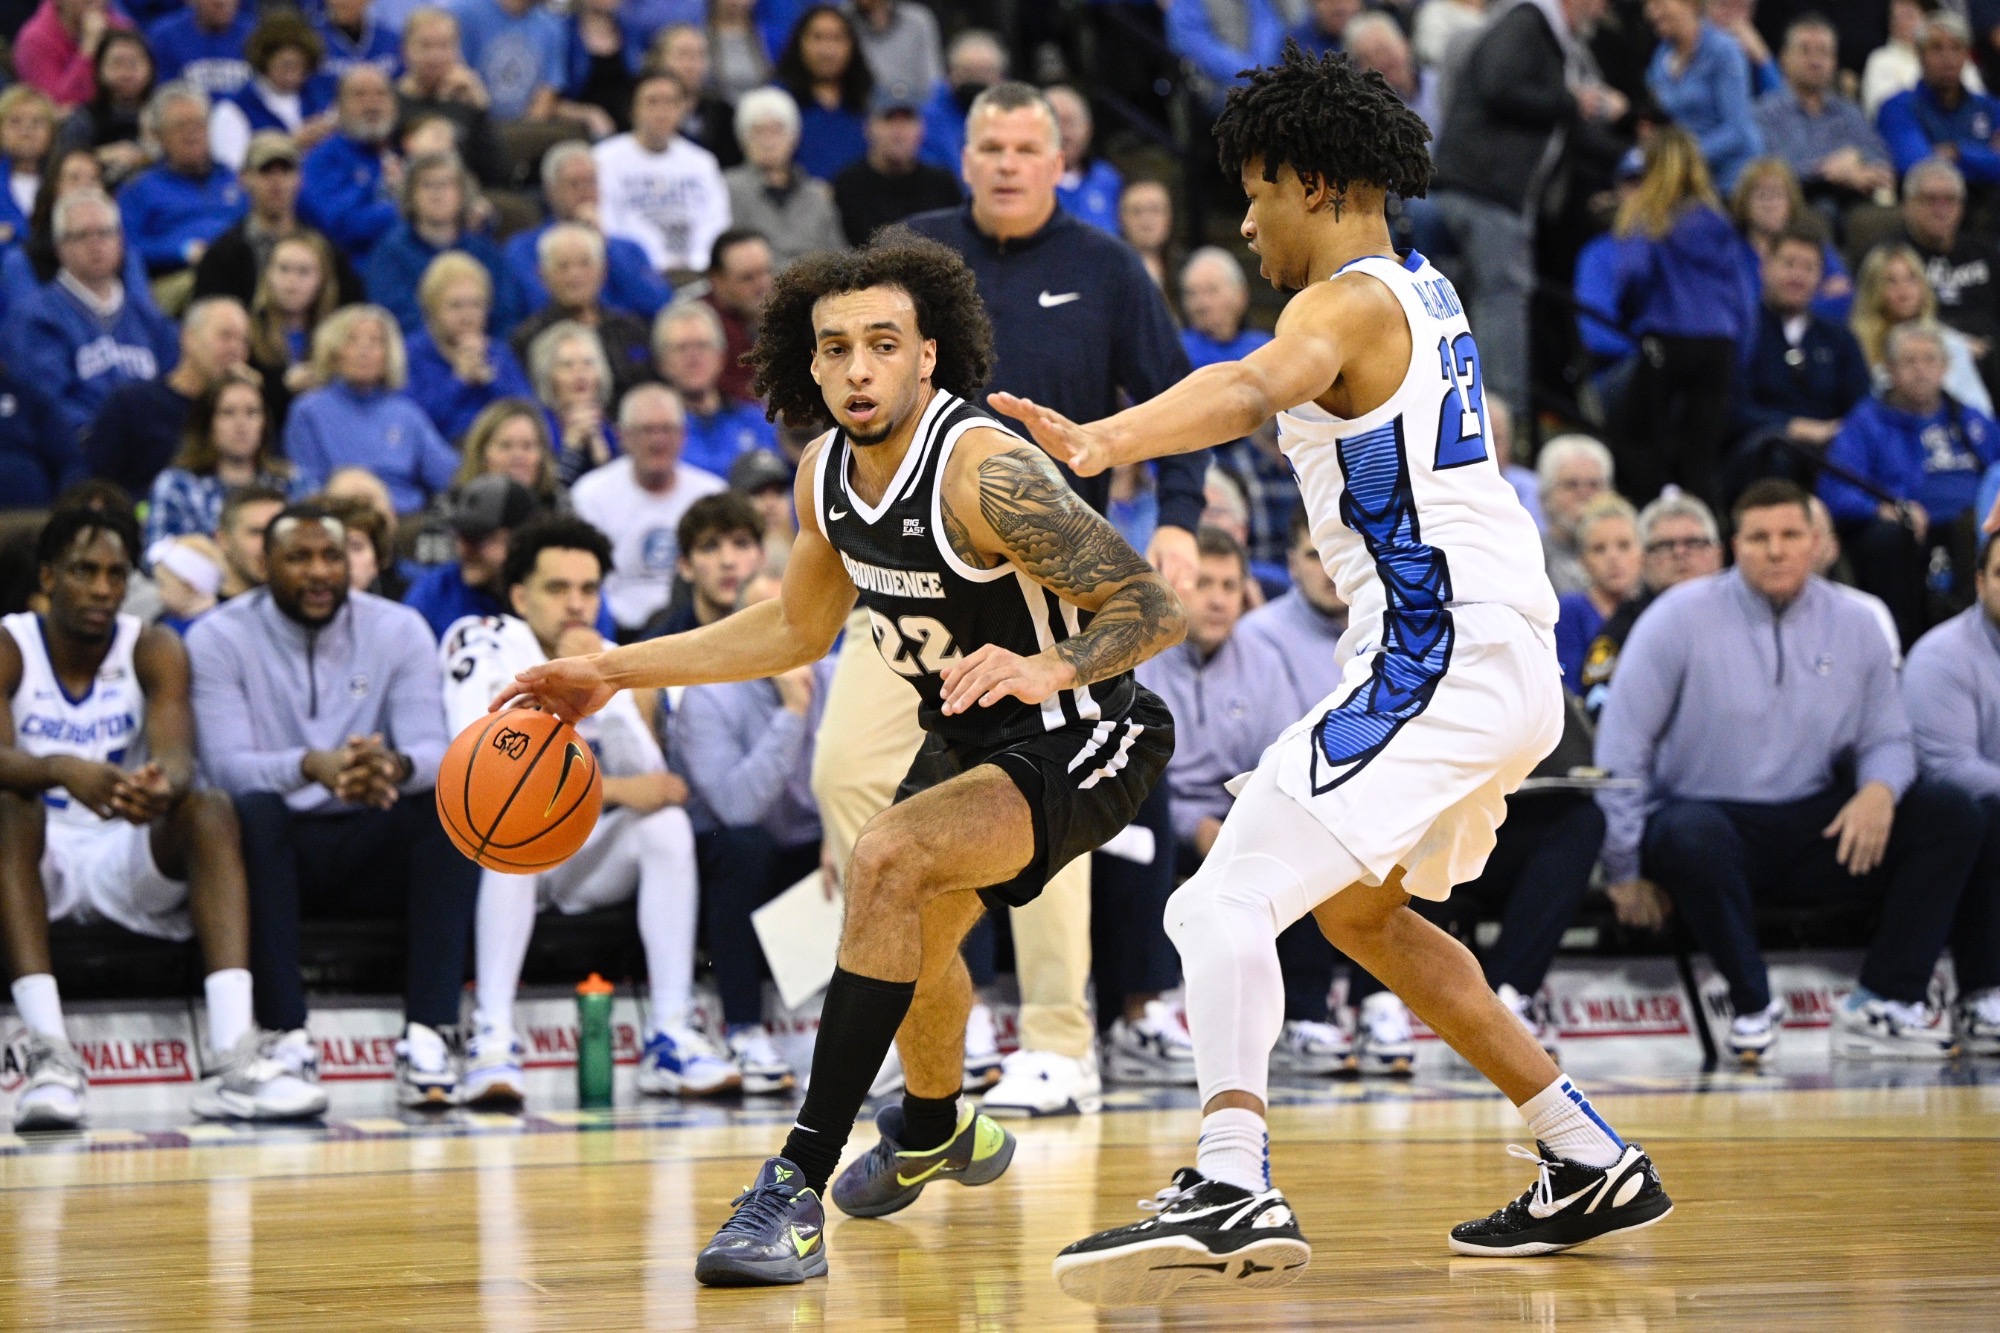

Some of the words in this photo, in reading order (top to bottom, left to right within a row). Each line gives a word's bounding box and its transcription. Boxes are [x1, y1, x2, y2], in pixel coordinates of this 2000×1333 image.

[1432, 331, 1489, 471] 23
[902, 526, 926, 534] EAST
[903, 518, 920, 527] BIG
[839, 548, 946, 599] PROVIDENCE
[867, 606, 965, 677] 22
[1586, 996, 1682, 1022] WALKER
[527, 1023, 638, 1053] WAR
[72, 1038, 189, 1071] WALKER
